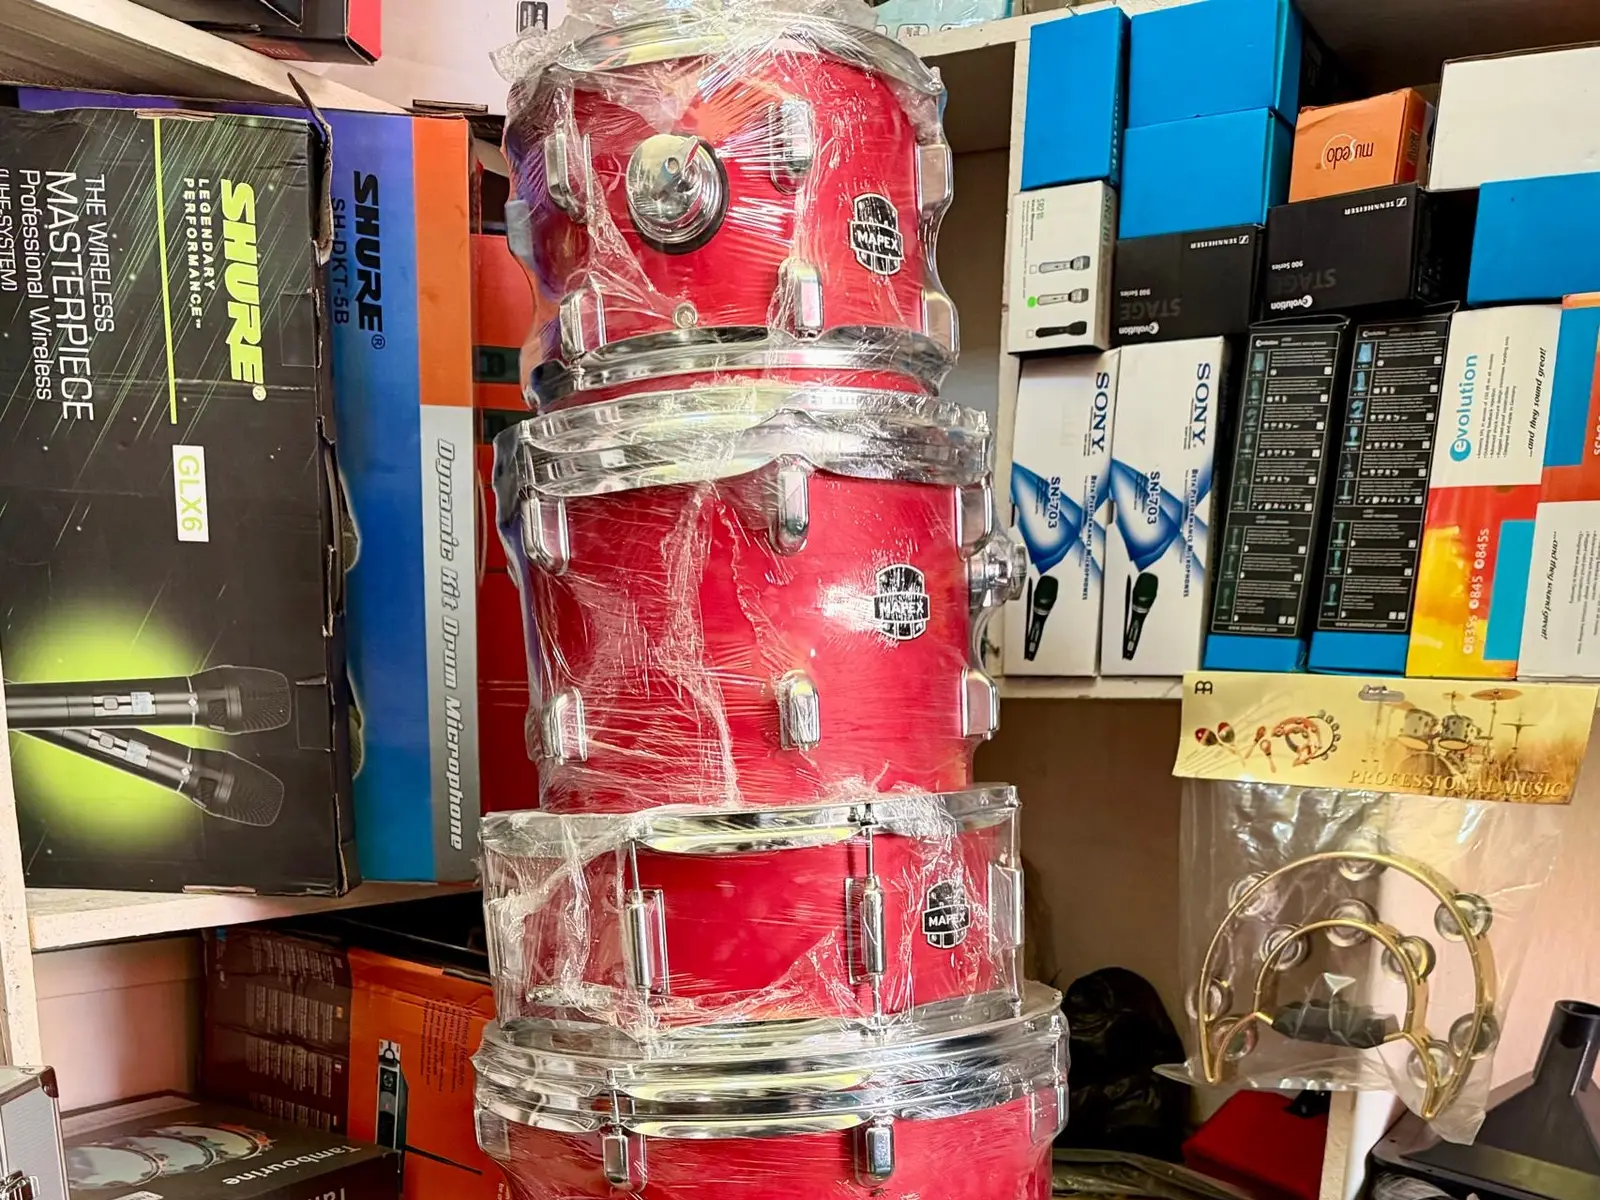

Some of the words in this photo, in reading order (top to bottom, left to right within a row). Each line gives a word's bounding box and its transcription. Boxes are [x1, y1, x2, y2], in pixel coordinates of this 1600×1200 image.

[1326, 139, 1374, 170] musedo
[85, 174, 106, 215] THE
[1344, 200, 1395, 215] SENNHEISER
[19, 169, 48, 298] Professional
[198, 178, 216, 289] LEGENDARY
[857, 231, 898, 253] MAPEX
[87, 222, 114, 332] WIRELESS
[1272, 262, 1290, 271] Series
[1291, 260, 1303, 268] 900
[46, 171, 93, 421] MASTERPIECE
[1270, 268, 1336, 295] STAGE
[1120, 298, 1181, 320] STAGE
[1271, 294, 1312, 311] evolution
[1119, 321, 1159, 336] evolution
[30, 306, 53, 400] Wireless
[1537, 347, 1547, 377] great!
[1192, 363, 1211, 446] SONY
[1533, 378, 1543, 407] sound
[1092, 372, 1109, 453] SONY
[1449, 355, 1478, 462] evolution
[1529, 409, 1539, 430] they
[177, 455, 203, 532] GLX6
[437, 438, 456, 561] Dynamic
[1047, 476, 1061, 529] SN-703
[1147, 471, 1161, 525] SN-703
[1547, 560, 1557, 581] they
[441, 567, 460, 611] Kit
[1544, 582, 1553, 612] sound
[878, 601, 924, 617] MAPEX
[1541, 611, 1549, 640] great!
[442, 616, 460, 689] Drum
[445, 696, 463, 850] Microphone
[1346, 770, 1501, 796] PROFESSIONAL
[1501, 777, 1564, 798] MUSIC
[928, 912, 967, 928] MAPEX
[221, 1143, 361, 1188] Tambourine
